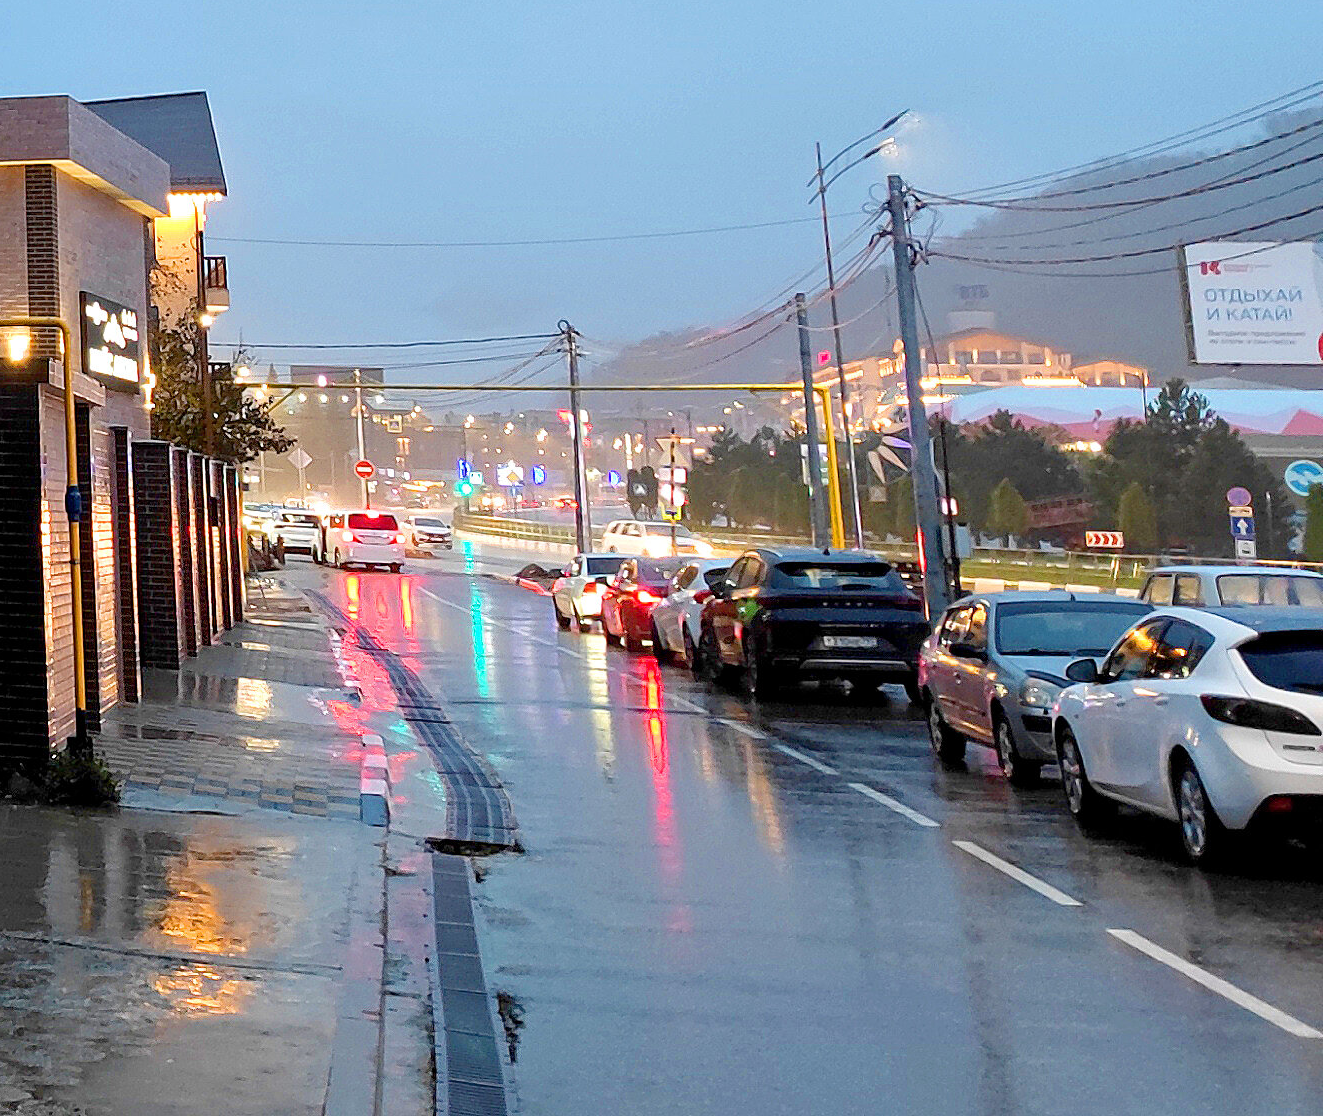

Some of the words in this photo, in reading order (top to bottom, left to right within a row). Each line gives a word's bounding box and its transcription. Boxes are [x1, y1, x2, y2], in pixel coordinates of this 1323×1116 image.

[1204, 286, 1303, 304] ОТДЫХАЙ
[1206, 307, 1220, 321] И
[1226, 305, 1293, 321] КАТАЙ!
